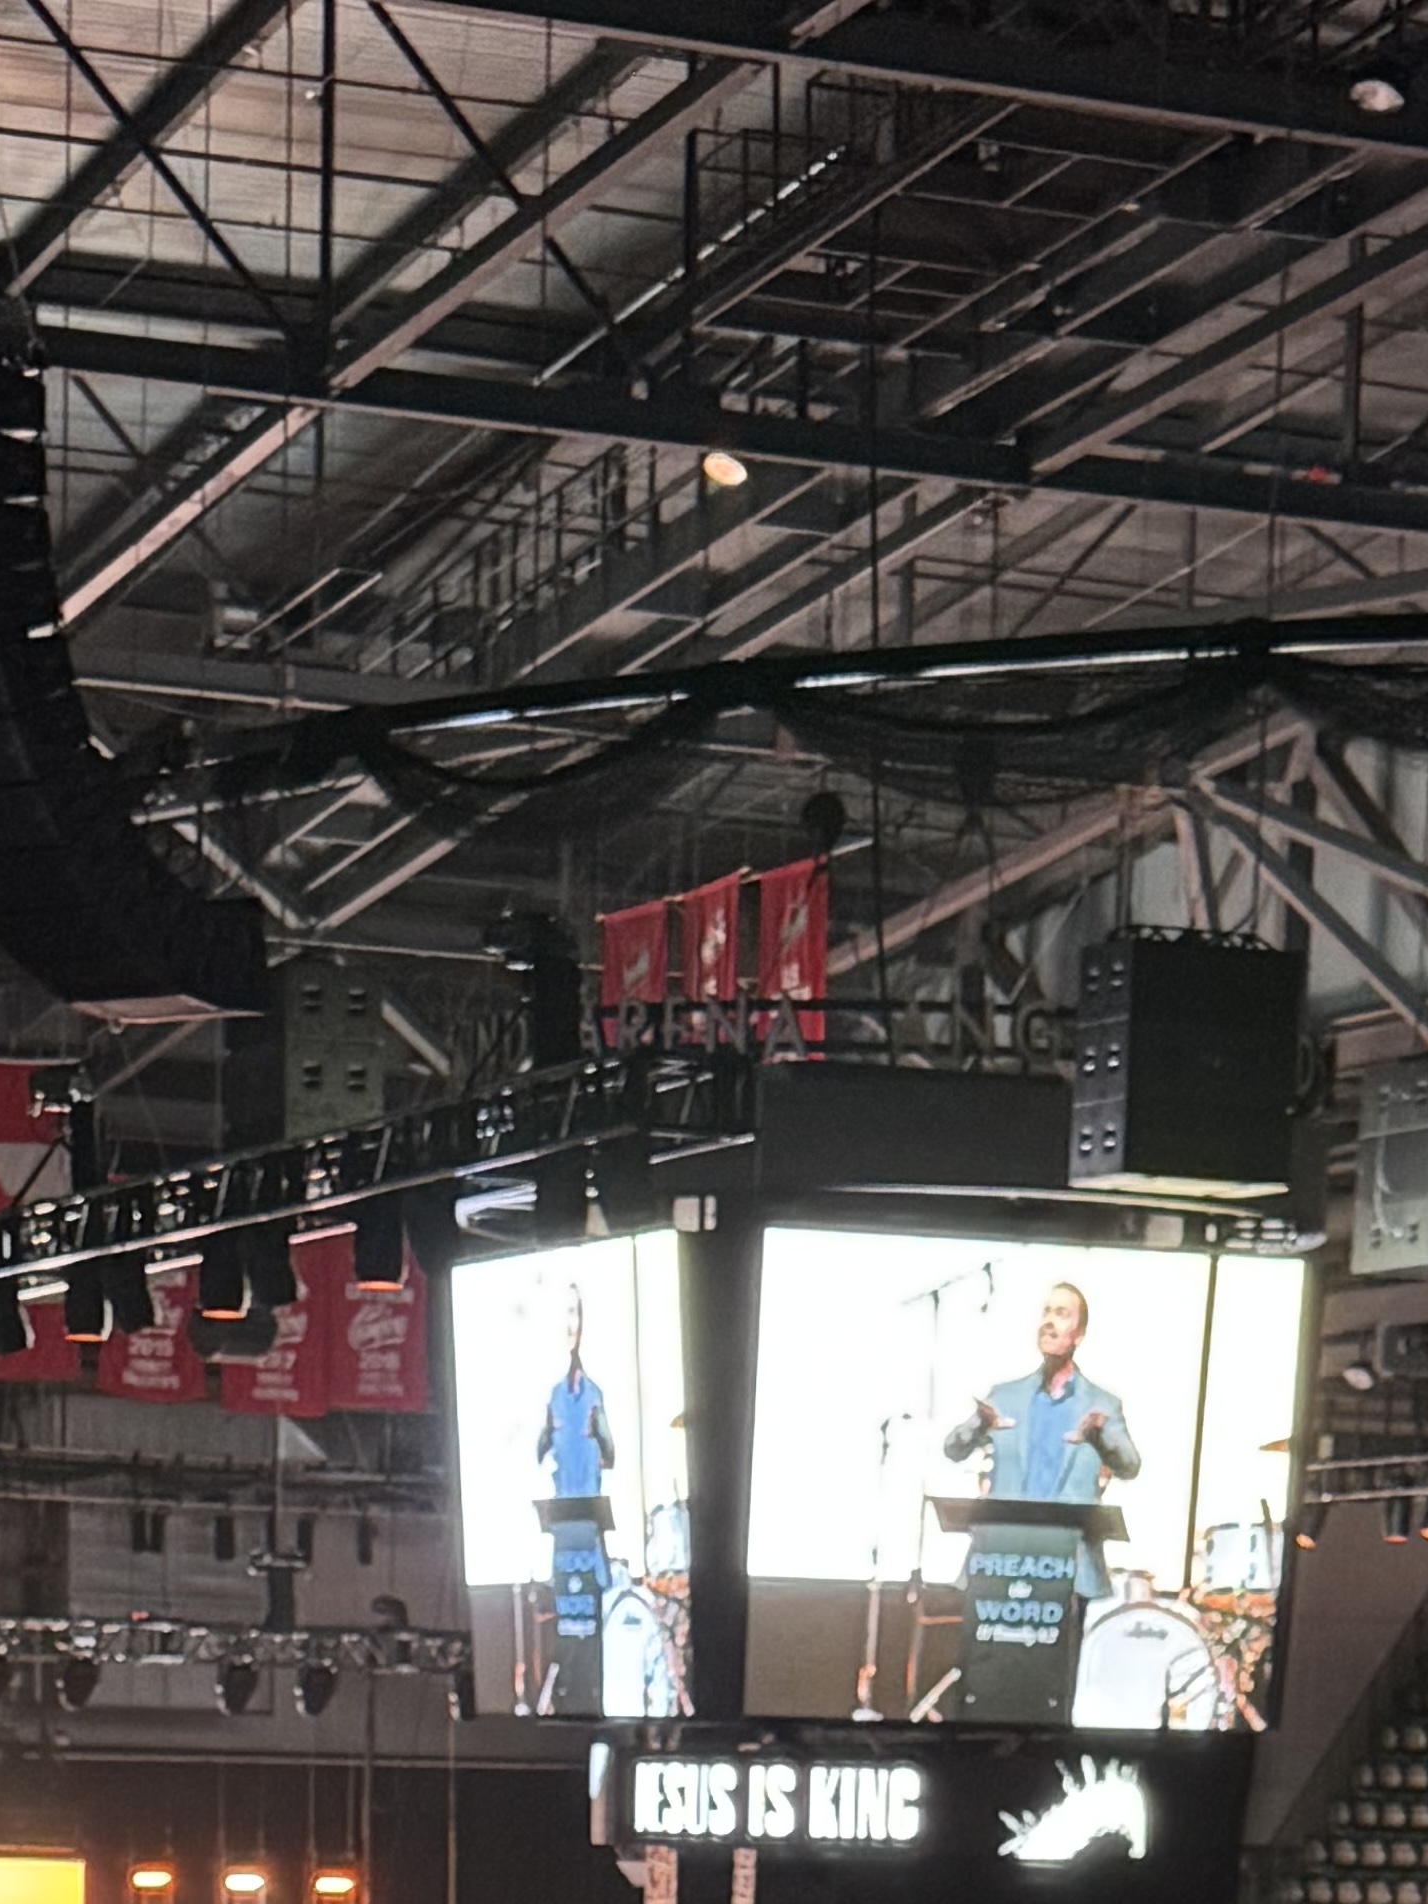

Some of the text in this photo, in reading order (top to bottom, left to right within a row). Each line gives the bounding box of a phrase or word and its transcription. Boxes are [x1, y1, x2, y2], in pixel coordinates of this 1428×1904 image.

[969, 1552, 1075, 1579] PREACH
[975, 1599, 1064, 1624] WORD
[634, 1761, 921, 1841] JESUS IS KING
